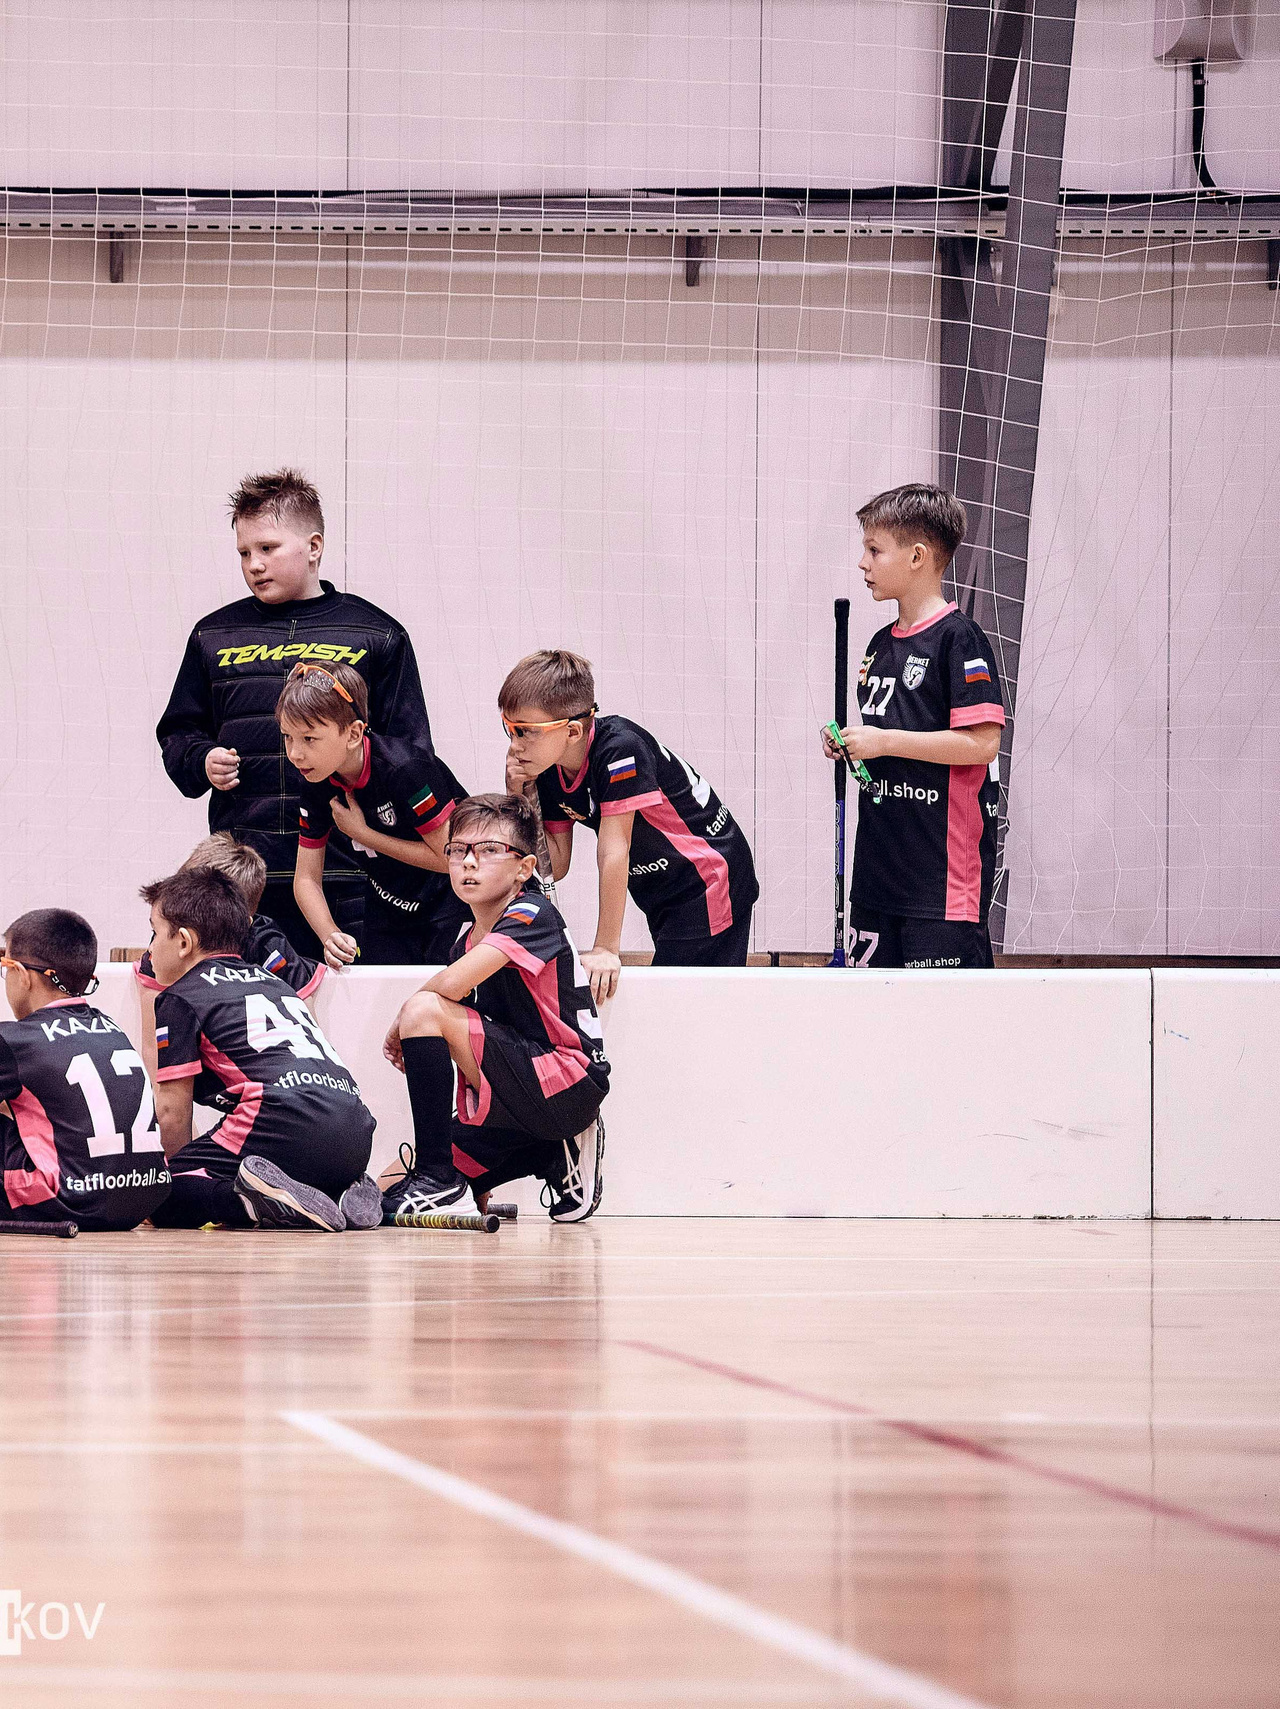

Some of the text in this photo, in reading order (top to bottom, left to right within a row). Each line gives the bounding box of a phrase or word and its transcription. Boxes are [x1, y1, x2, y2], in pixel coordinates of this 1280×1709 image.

[217, 643, 368, 667] TEMPISH
[861, 675, 897, 716] 27
[65, 1049, 165, 1158] 12
